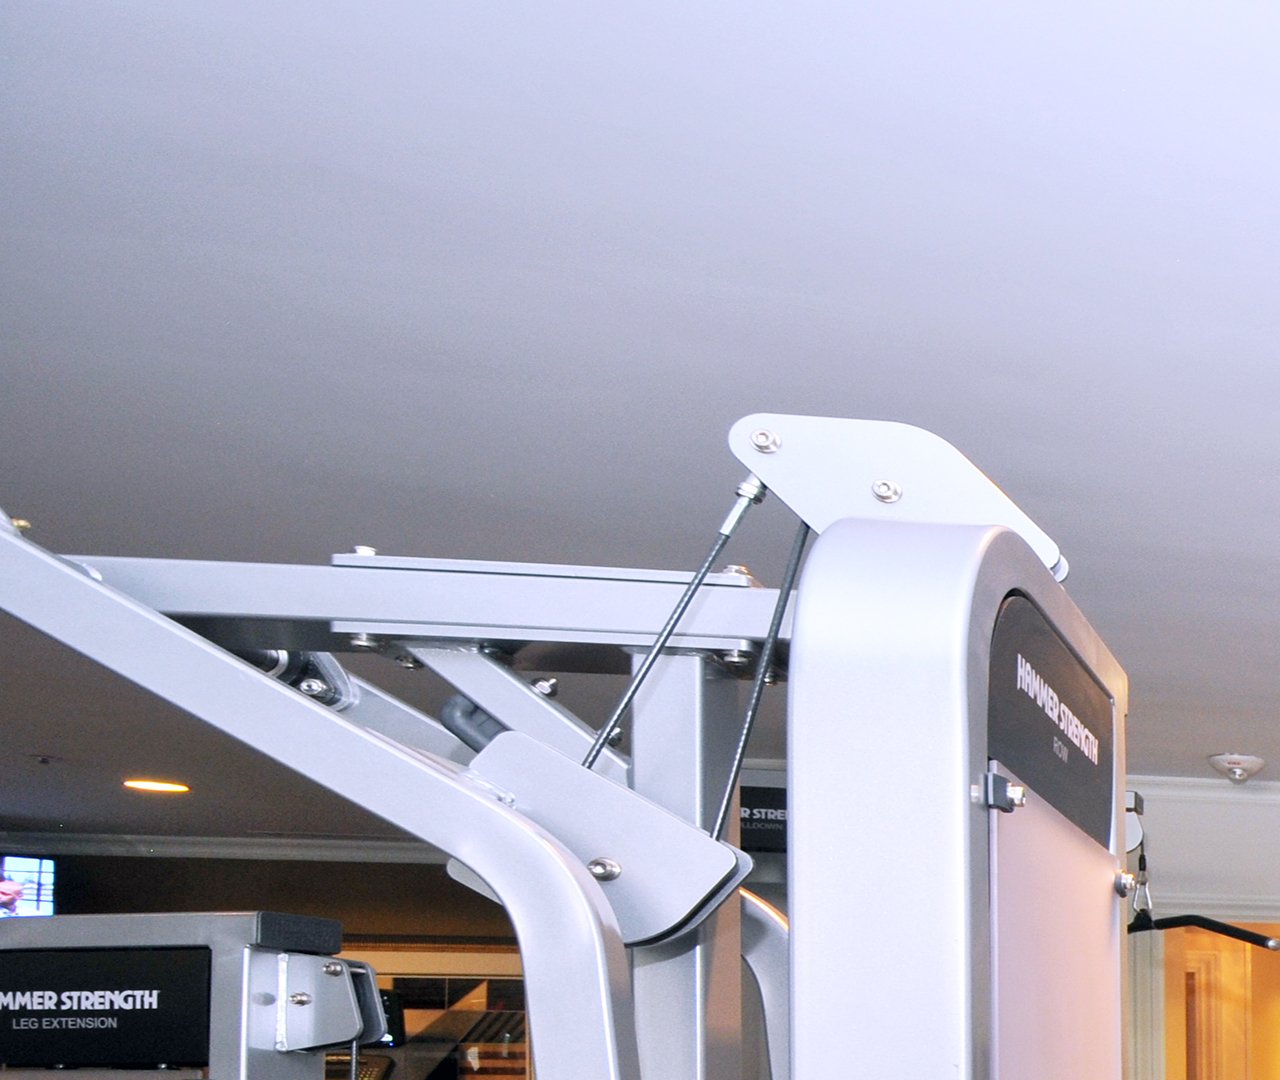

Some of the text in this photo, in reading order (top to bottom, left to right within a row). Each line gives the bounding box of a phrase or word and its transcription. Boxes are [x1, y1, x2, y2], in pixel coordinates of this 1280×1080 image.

[1017, 652, 1098, 765] HAMMER STRENGTH
[60, 989, 159, 1011] STRENGTH
[12, 1017, 118, 1029] LEG EXTENSION
